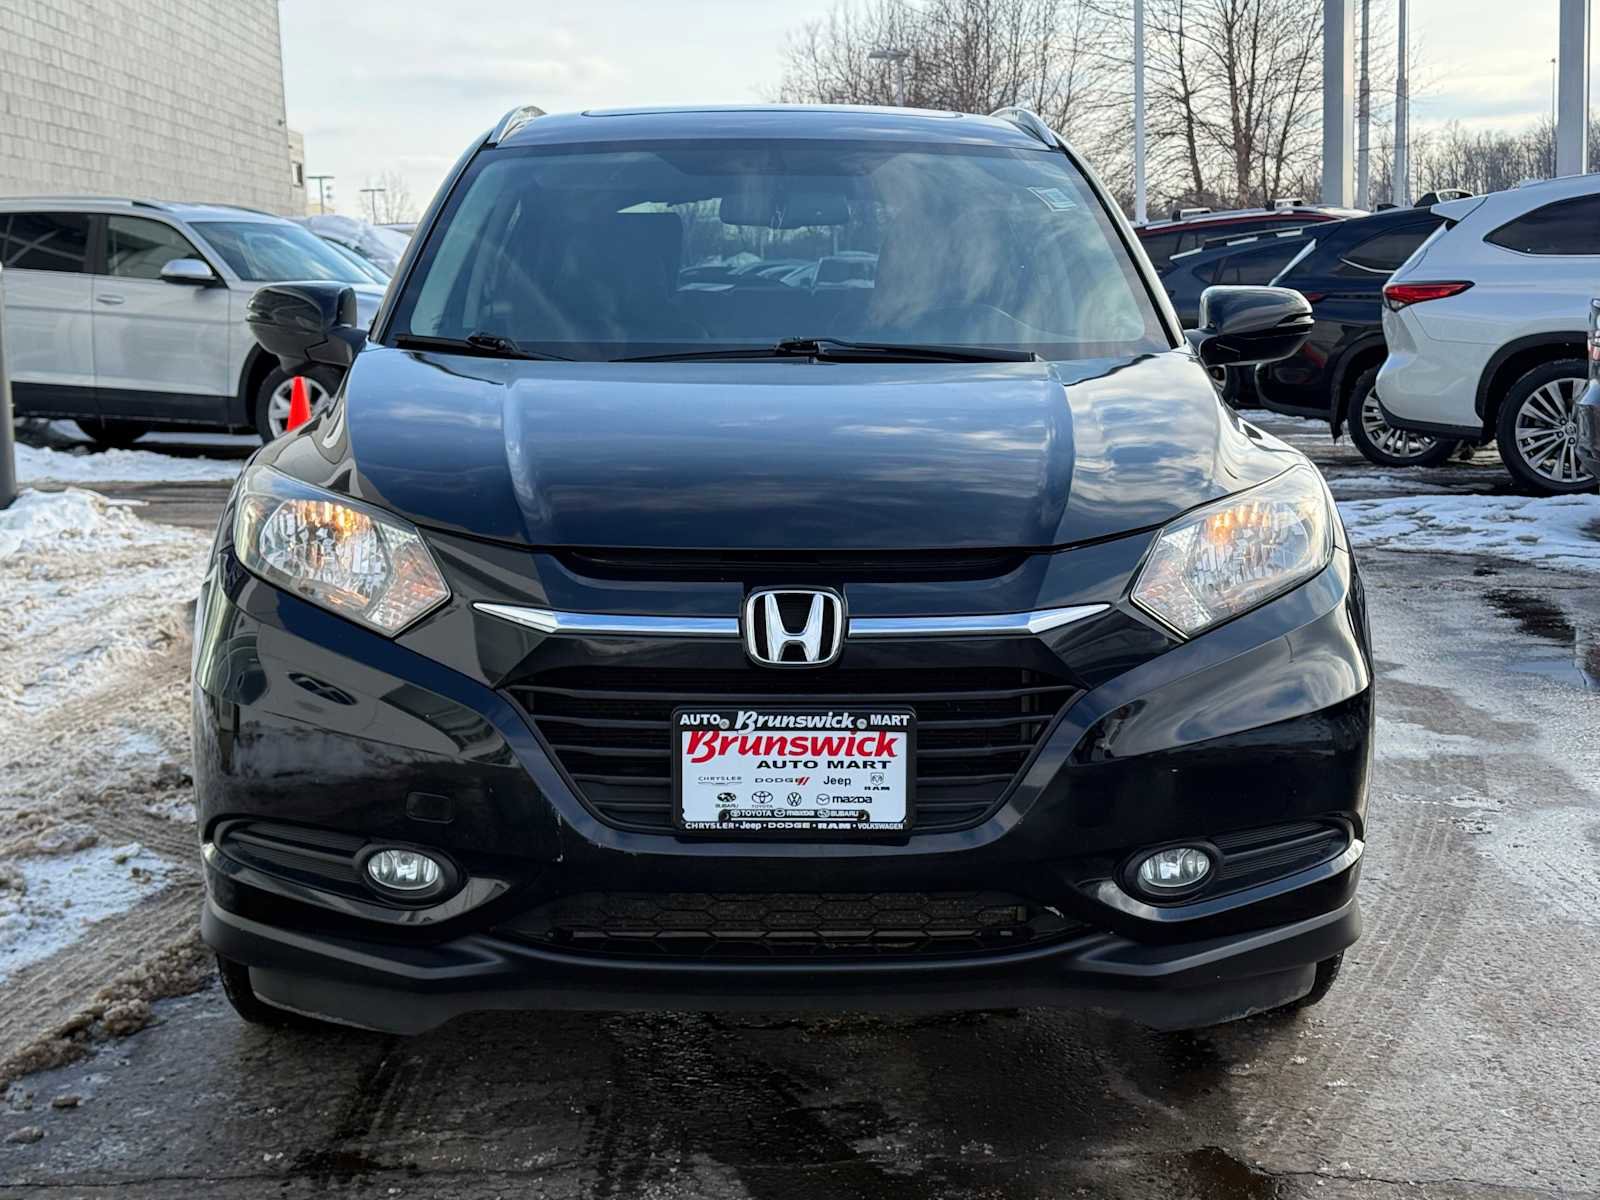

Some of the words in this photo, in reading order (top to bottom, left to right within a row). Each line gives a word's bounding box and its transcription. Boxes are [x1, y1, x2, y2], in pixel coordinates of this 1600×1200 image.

[680, 713, 721, 725] AUTO
[734, 710, 855, 735] Brunswick
[869, 714, 910, 726] MART
[687, 728, 899, 763] Brunswick
[757, 760, 819, 769] AUTO
[827, 760, 892, 769] MART
[823, 776, 852, 788] Jeep
[685, 822, 735, 830] CHRYSLER
[740, 821, 762, 831] Jeep
[817, 822, 852, 830] RAM
